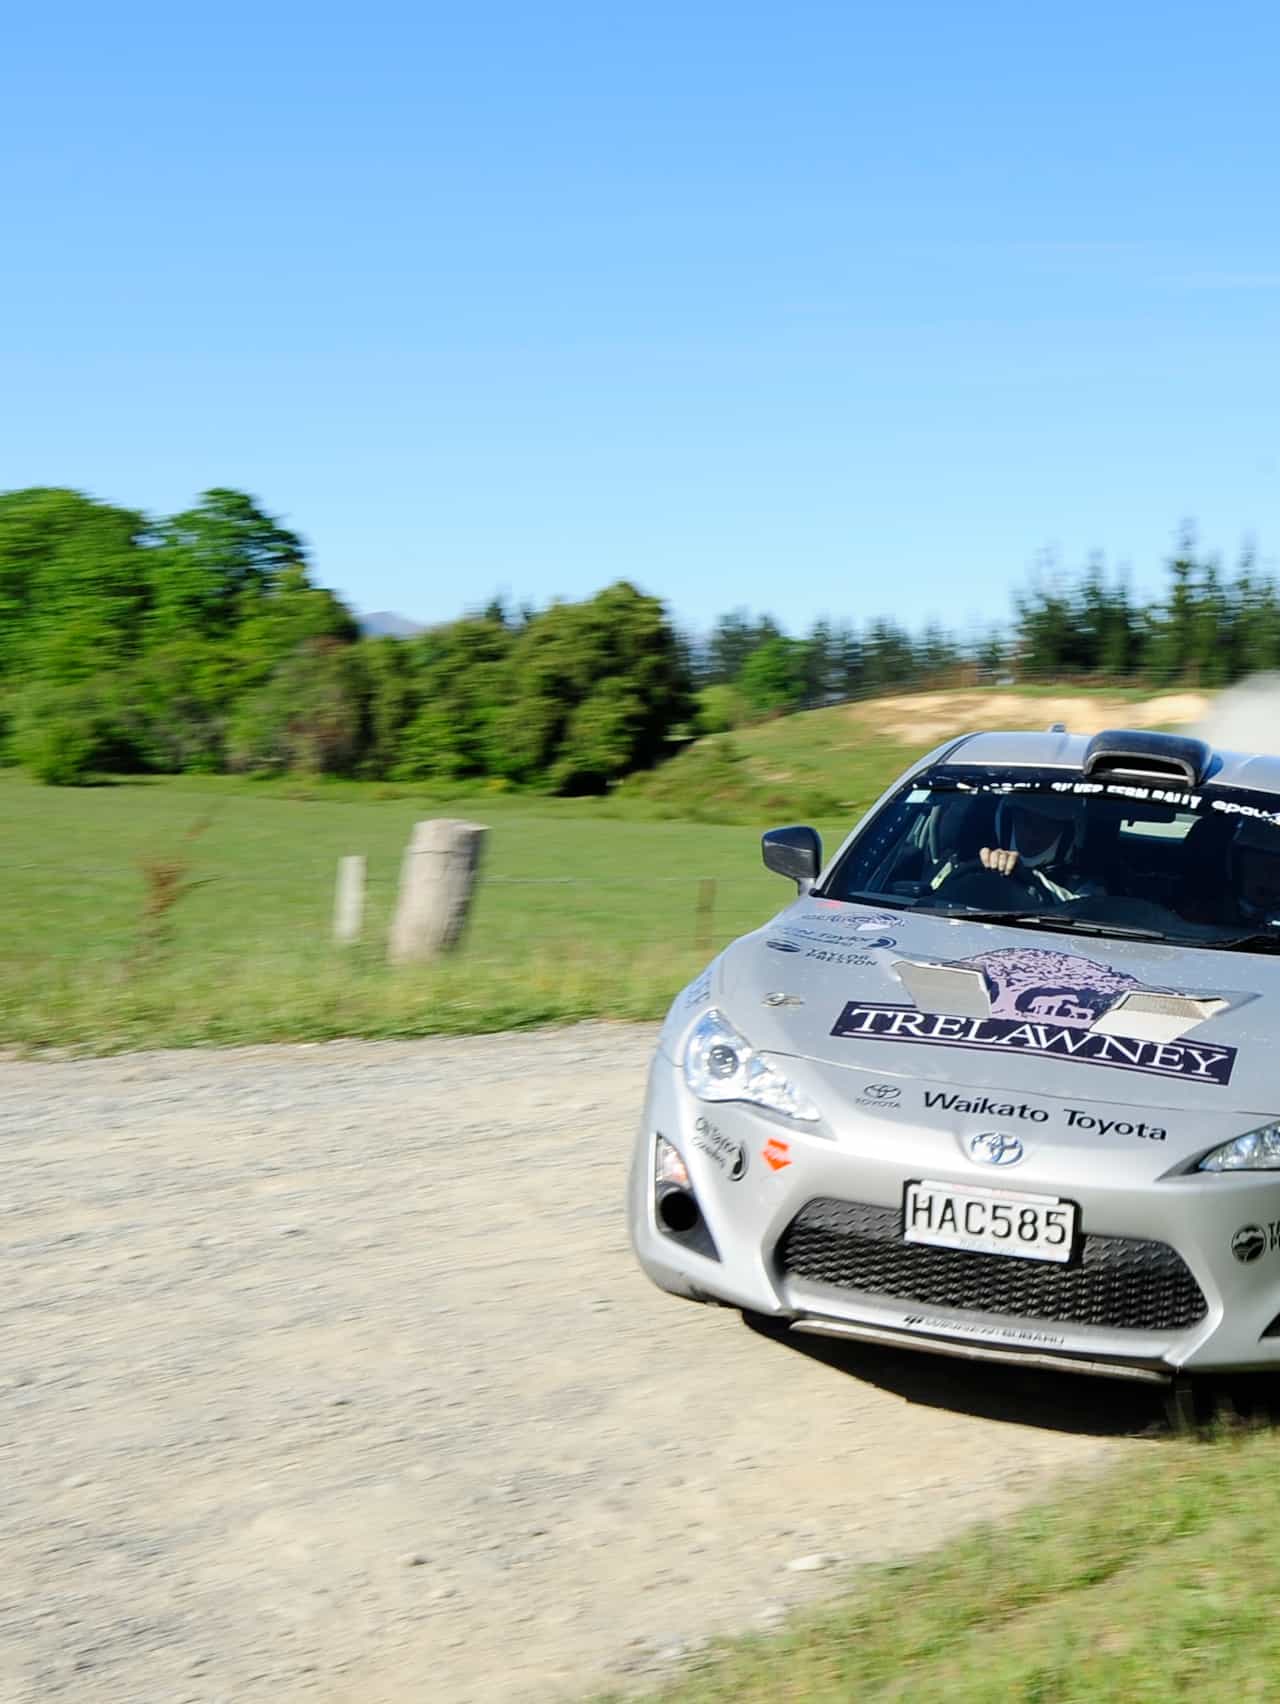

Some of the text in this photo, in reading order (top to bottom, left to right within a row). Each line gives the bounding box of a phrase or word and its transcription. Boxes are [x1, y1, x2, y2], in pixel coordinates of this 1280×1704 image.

[850, 1008, 1229, 1075] TRELAWNEY
[923, 1090, 1168, 1141] Waikato Toyota
[912, 1192, 1067, 1245] HAC585
